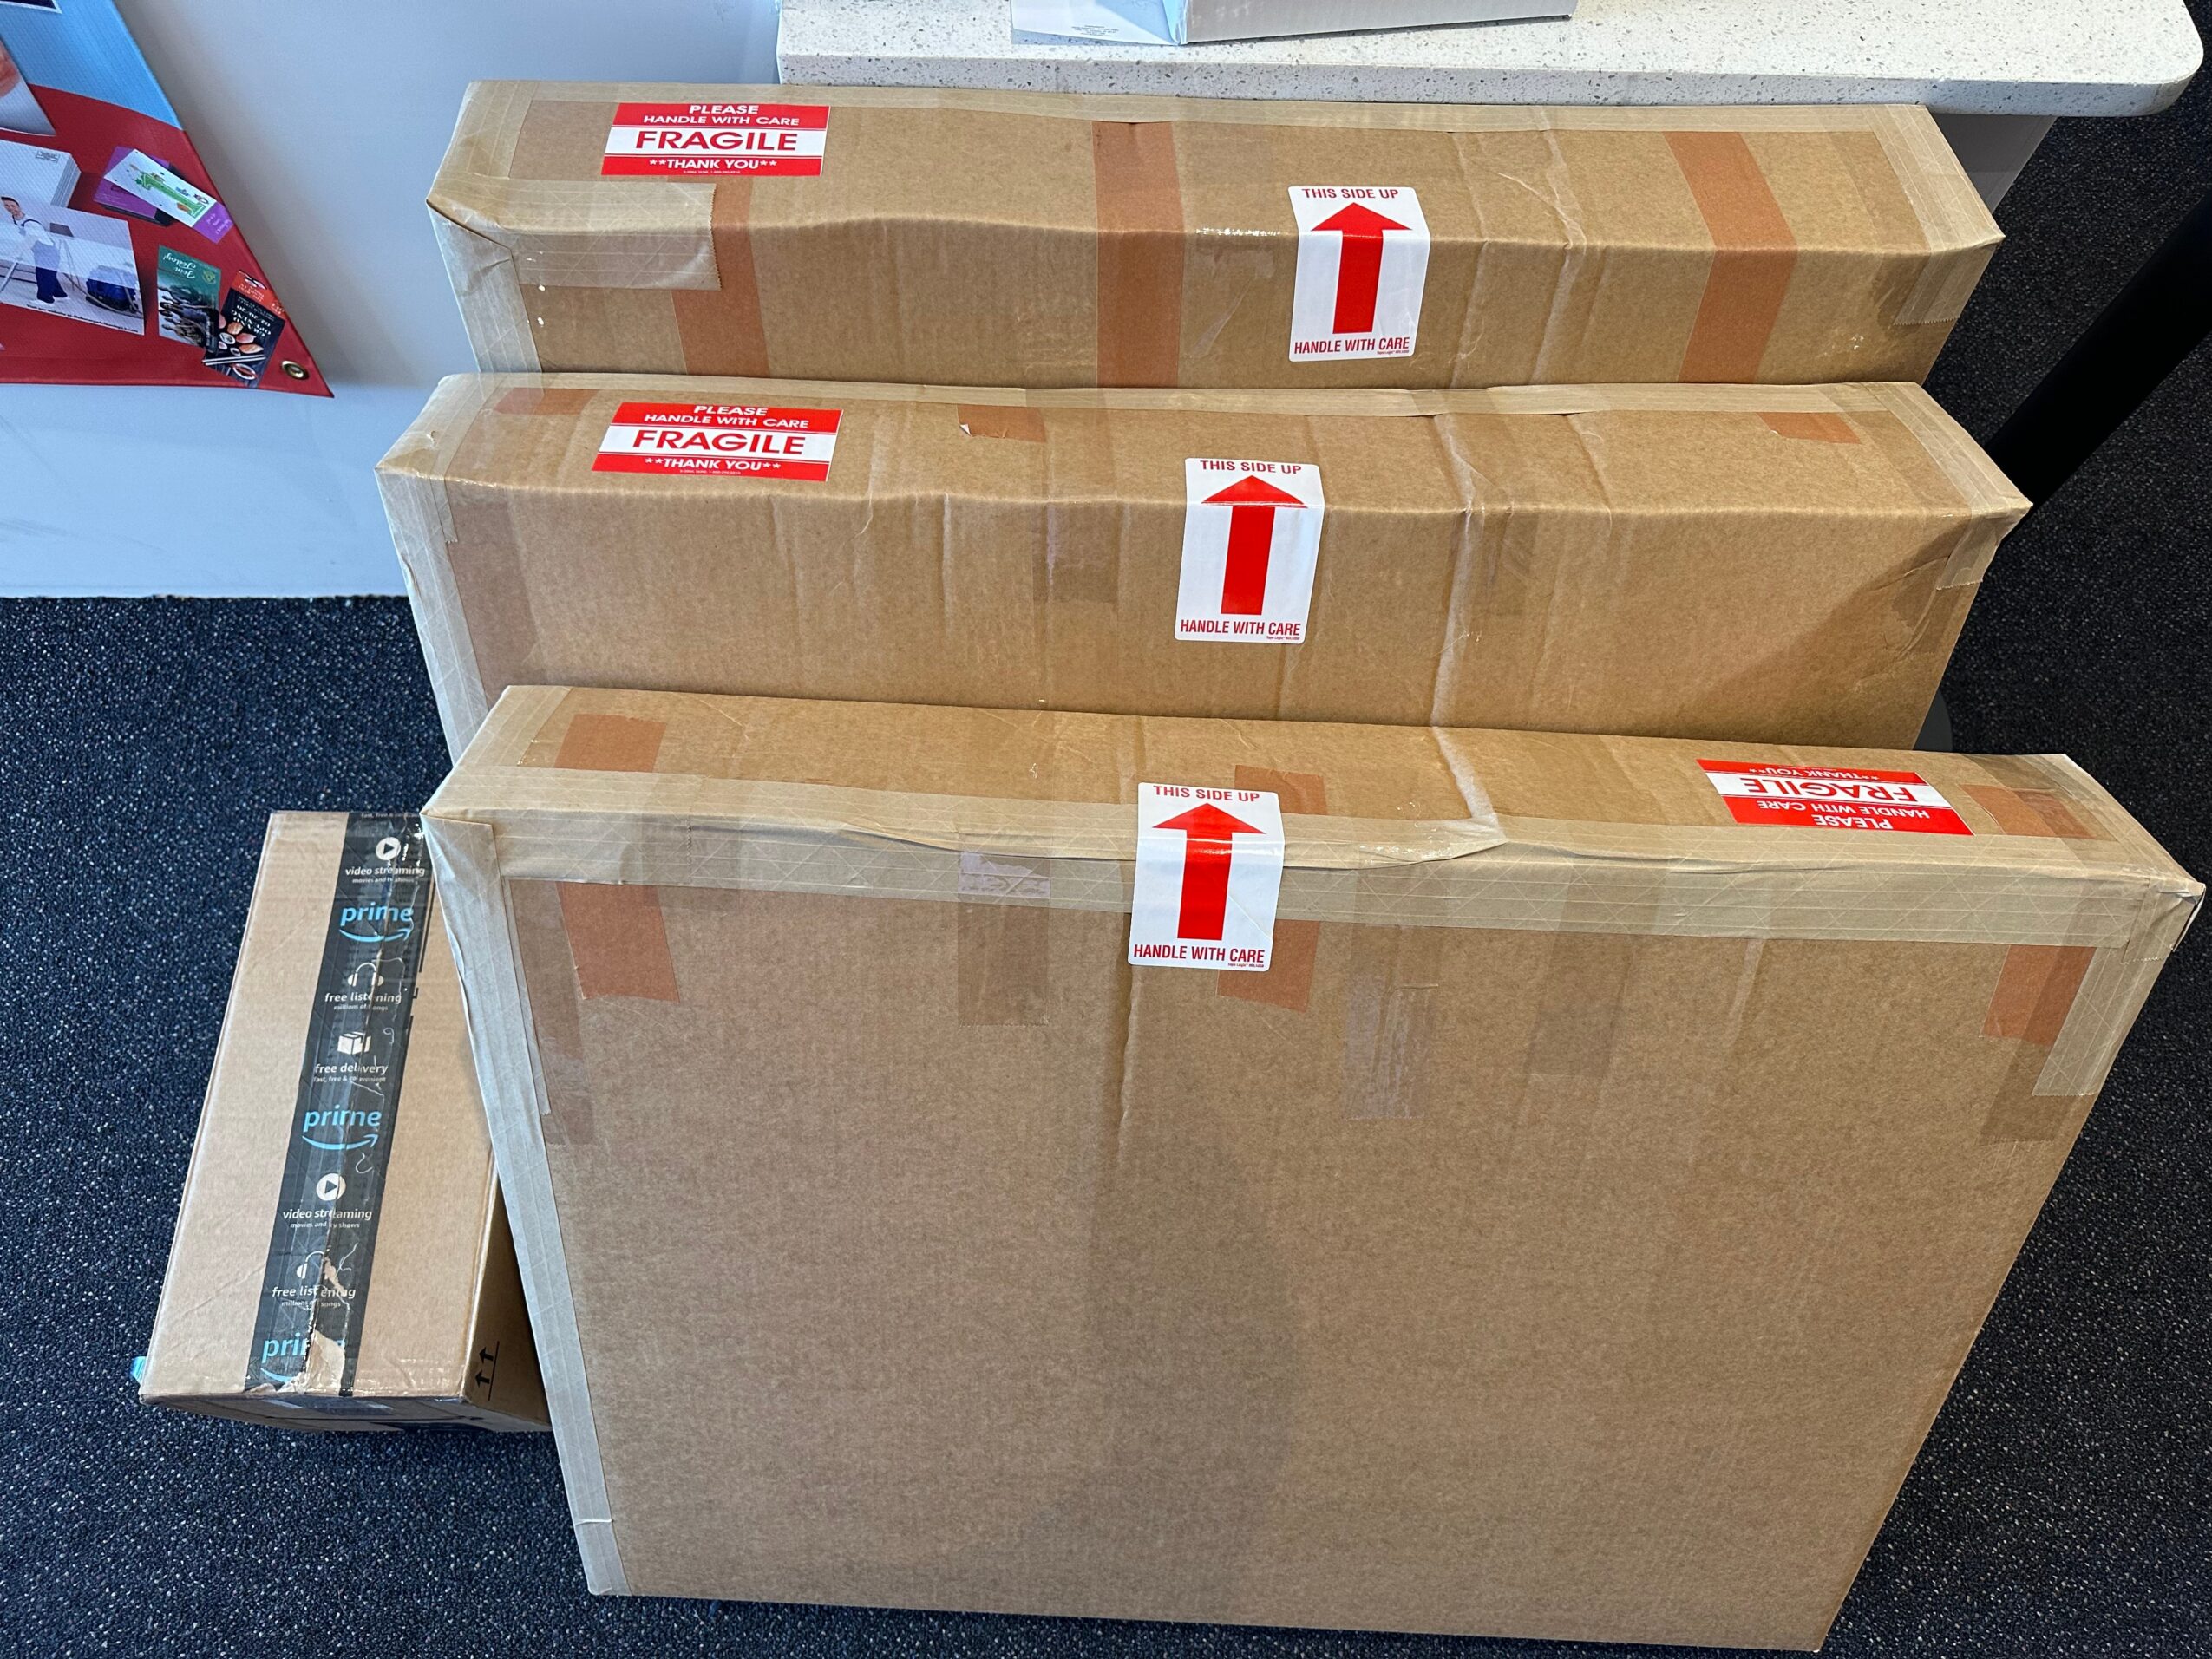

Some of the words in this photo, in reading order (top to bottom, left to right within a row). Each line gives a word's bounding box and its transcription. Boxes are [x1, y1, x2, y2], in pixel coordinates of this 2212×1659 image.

[690, 105, 759, 114] PLEASE
[643, 114, 707, 124] HANDLE
[711, 115, 750, 125] WITH
[756, 116, 800, 126] CARE
[635, 130, 798, 151] FRAGILE
[1302, 188, 1337, 199] THIS
[1341, 188, 1376, 199] SIDE
[1379, 189, 1399, 199] UP
[1294, 340, 1342, 354] HANDLE
[1345, 338, 1375, 351] WITH
[1378, 336, 1410, 350] CARE
[694, 405, 768, 416] PLEASE
[644, 414, 711, 424] HANDLE
[717, 416, 757, 427] WITH
[762, 418, 808, 428] CARE
[632, 429, 806, 455] FRAGILE
[1200, 460, 1235, 471] THIS
[1240, 461, 1276, 473] SIDE
[1281, 464, 1302, 474] UP
[1180, 619, 1230, 634] HANDLE
[1234, 621, 1265, 635] WITH
[1268, 622, 1301, 636] CARE
[1153, 785, 1190, 798] THIS
[1195, 788, 1233, 801] SIDE
[1238, 792, 1260, 802] UP
[1739, 777, 1919, 803] FRAGILE
[1757, 800, 1807, 811] CARE
[1811, 803, 1857, 814] WITH
[1860, 806, 1930, 819] HANDLE
[1811, 814, 1894, 830] PLEASE
[345, 866, 372, 876] video
[374, 865, 425, 877] streaming
[340, 901, 414, 927] prime
[1133, 944, 1188, 959] HANDLE
[1191, 946, 1226, 962] WITH
[1229, 948, 1266, 963] CARE
[324, 992, 348, 1003] free
[315, 1063, 337, 1074] free
[340, 1062, 389, 1075] delivery
[303, 1104, 382, 1133] prime
[283, 1208, 312, 1219] video
[314, 1208, 373, 1221] streaming
[272, 1286, 296, 1297] free
[261, 1332, 345, 1363] pri
